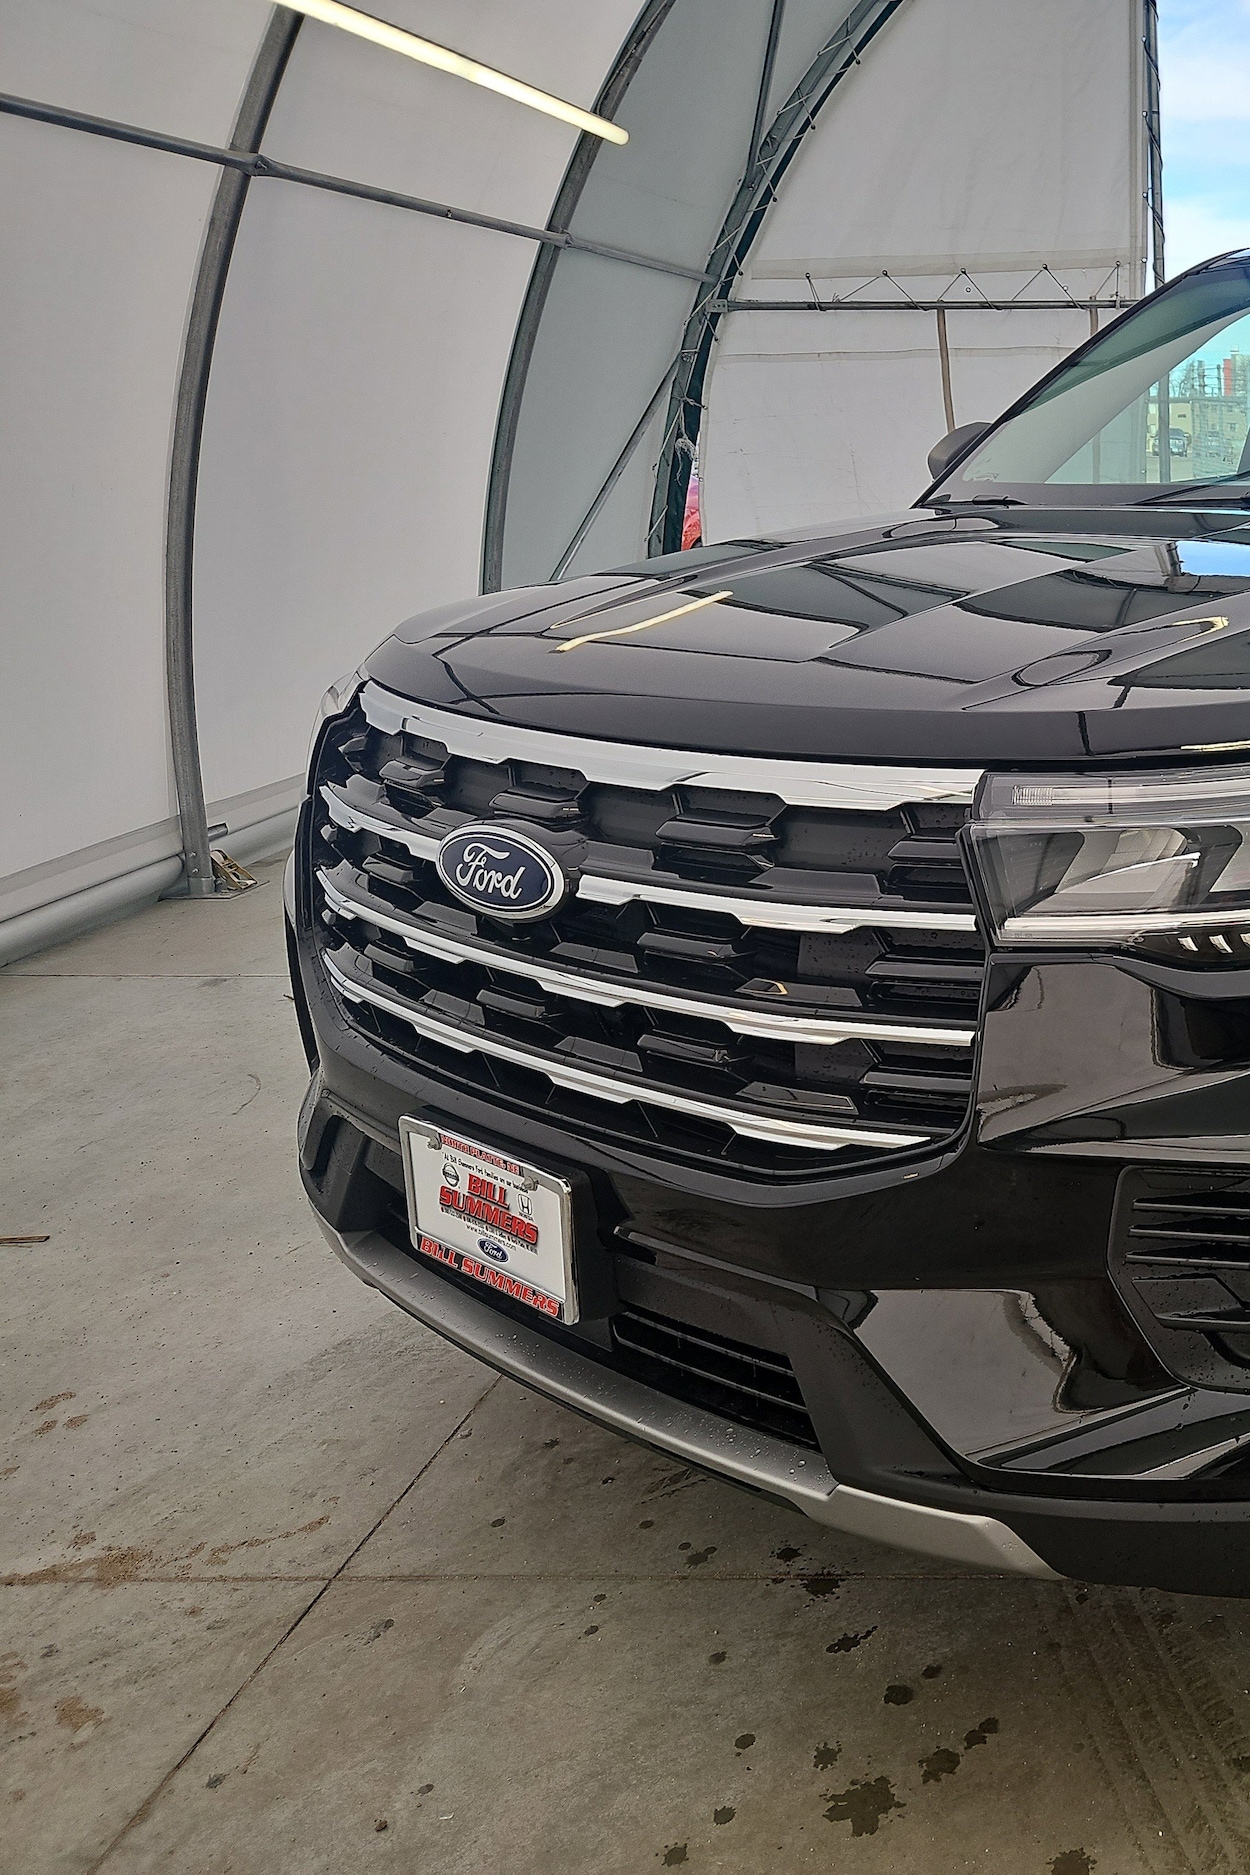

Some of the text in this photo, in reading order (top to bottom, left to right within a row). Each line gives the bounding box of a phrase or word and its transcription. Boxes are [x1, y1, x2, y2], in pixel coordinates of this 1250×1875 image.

[455, 842, 526, 900] Ford
[439, 1185, 538, 1245] SUMMERS
[467, 1173, 510, 1209] BILL
[419, 1237, 458, 1268] BILL
[461, 1257, 559, 1318] SUMMERS
[484, 1241, 503, 1260] Ford
